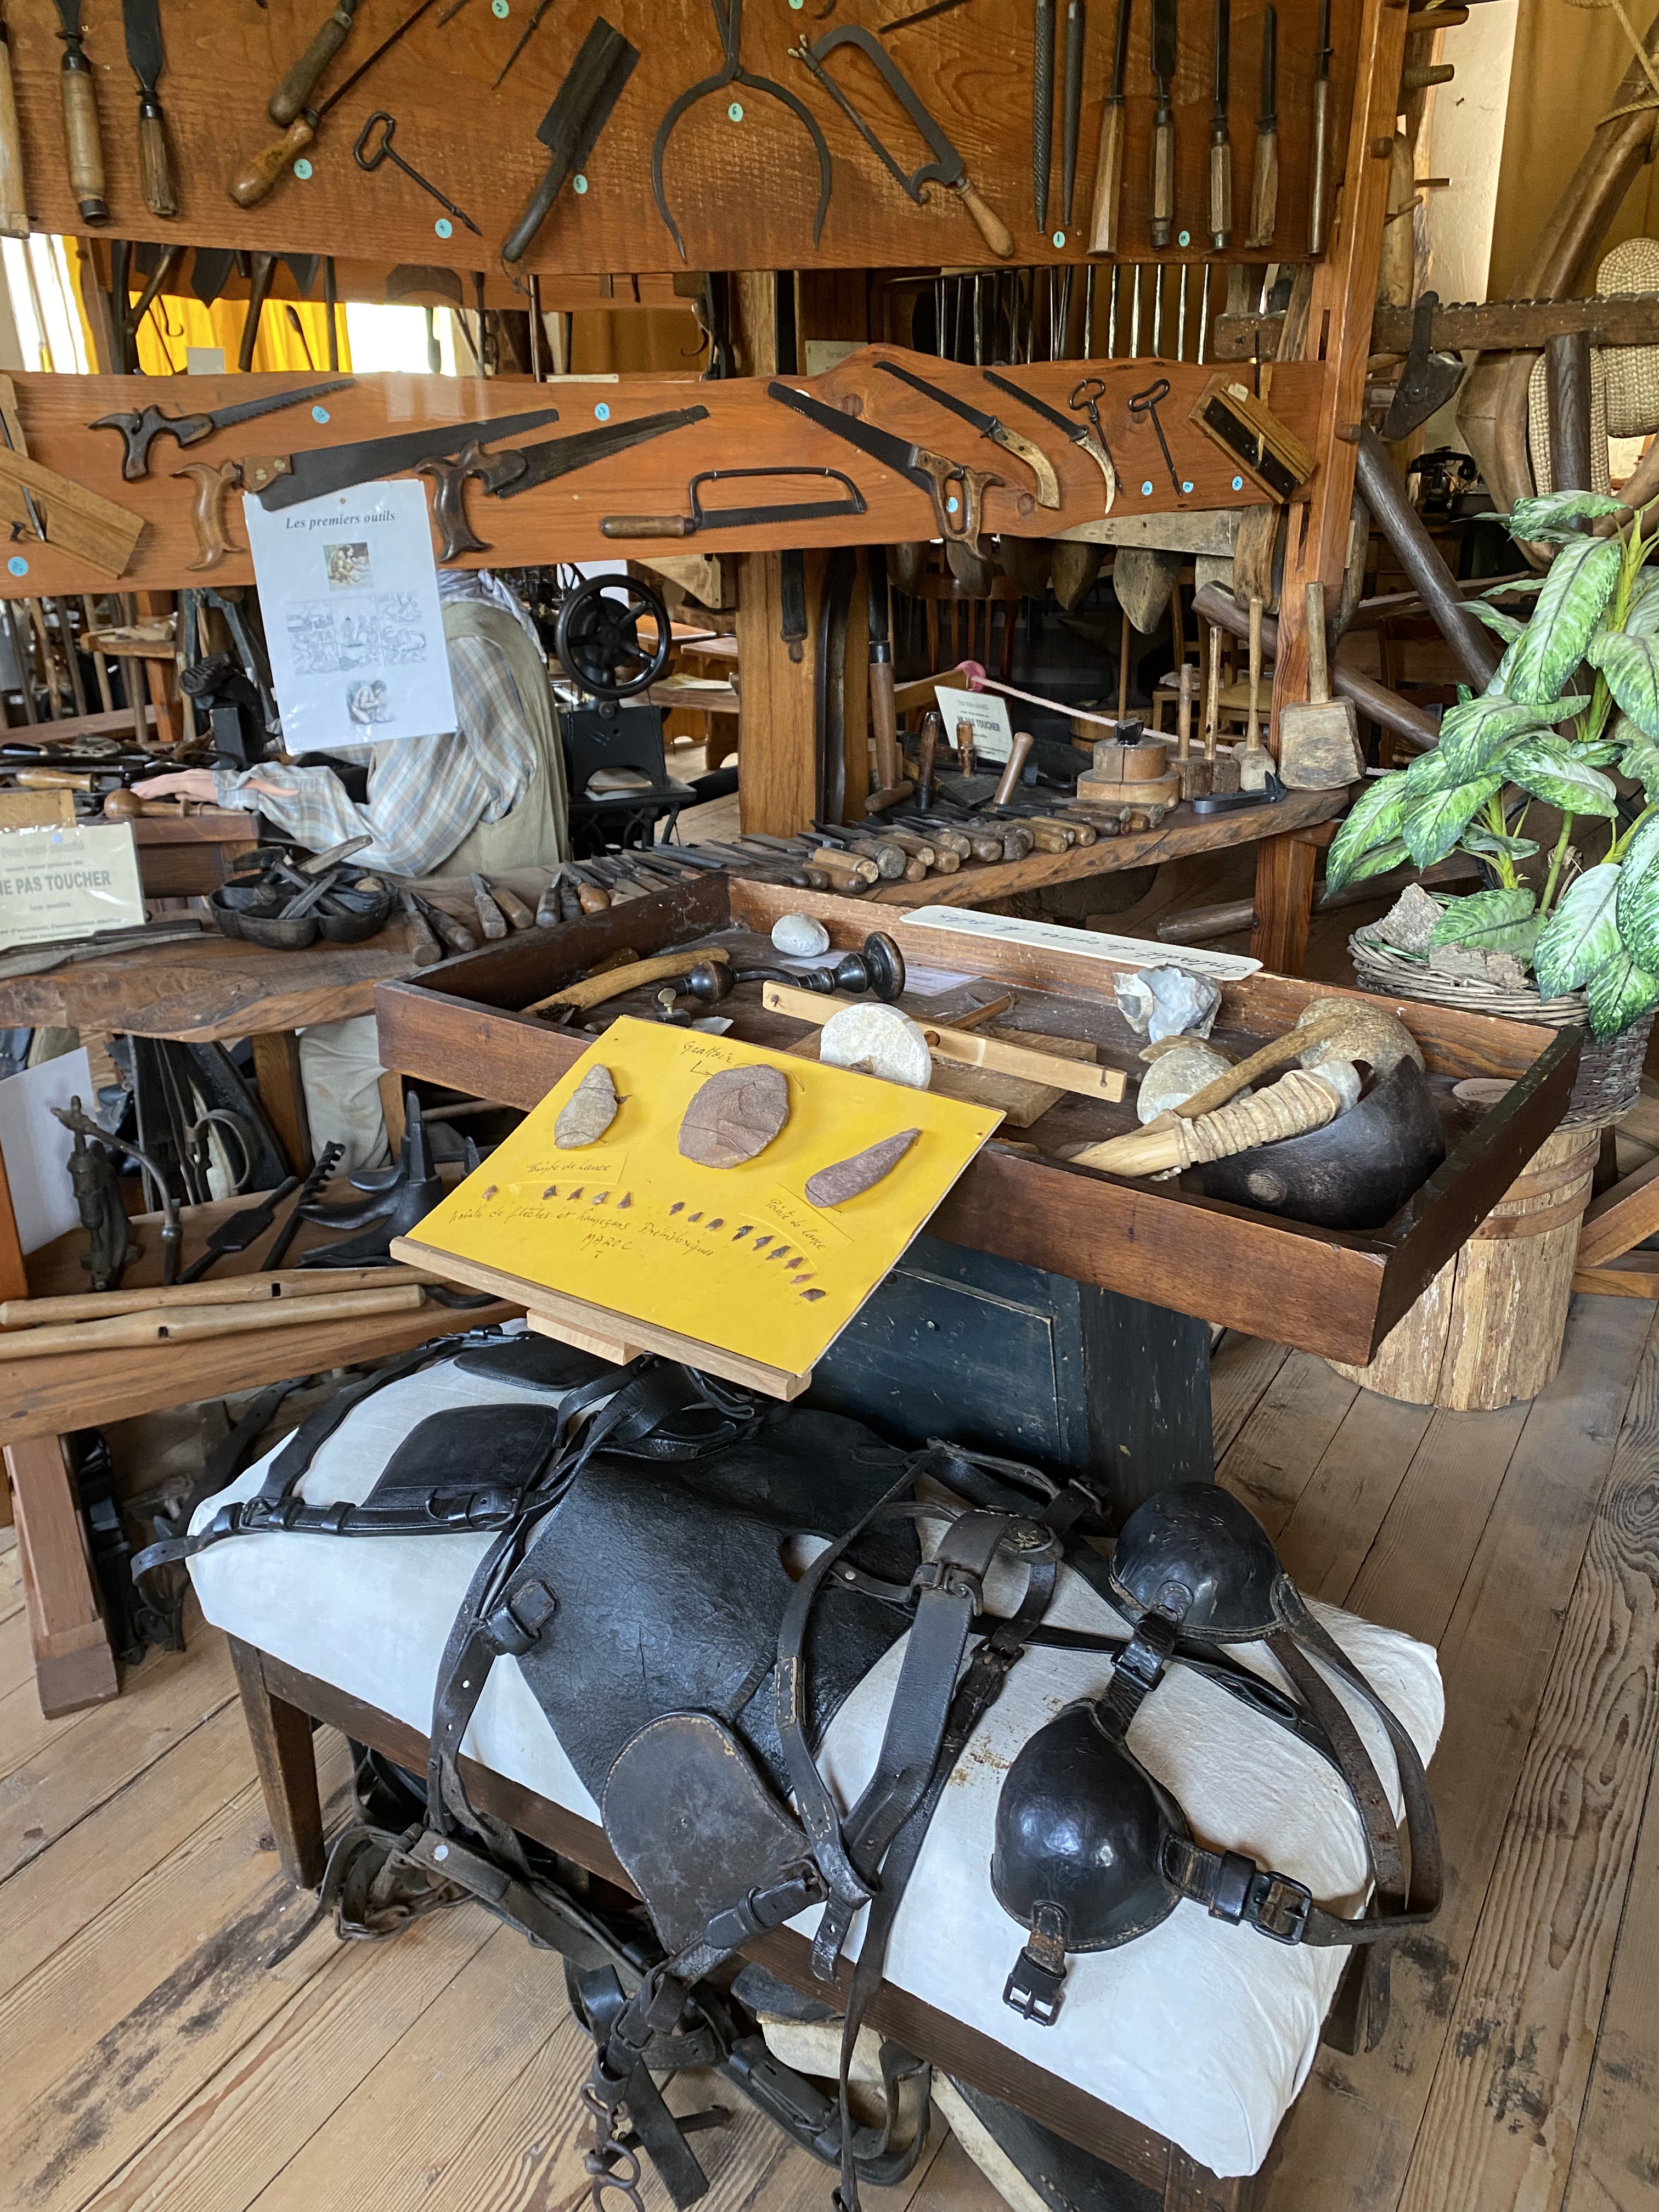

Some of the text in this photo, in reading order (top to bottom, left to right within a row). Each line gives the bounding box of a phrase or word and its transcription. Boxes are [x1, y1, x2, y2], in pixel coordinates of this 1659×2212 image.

[286, 510, 395, 530] Les premiers outils
[975, 719, 1001, 732] TOUCHER
[15, 877, 42, 894] PAS
[44, 870, 111, 891] TOUCHER
[939, 913, 995, 925] silex
[1041, 932, 1099, 944] casser
[1135, 951, 1248, 974] Interdit
[562, 1161, 576, 1170] de
[489, 1206, 504, 1217] de
[580, 1233, 633, 1251] MAROC
